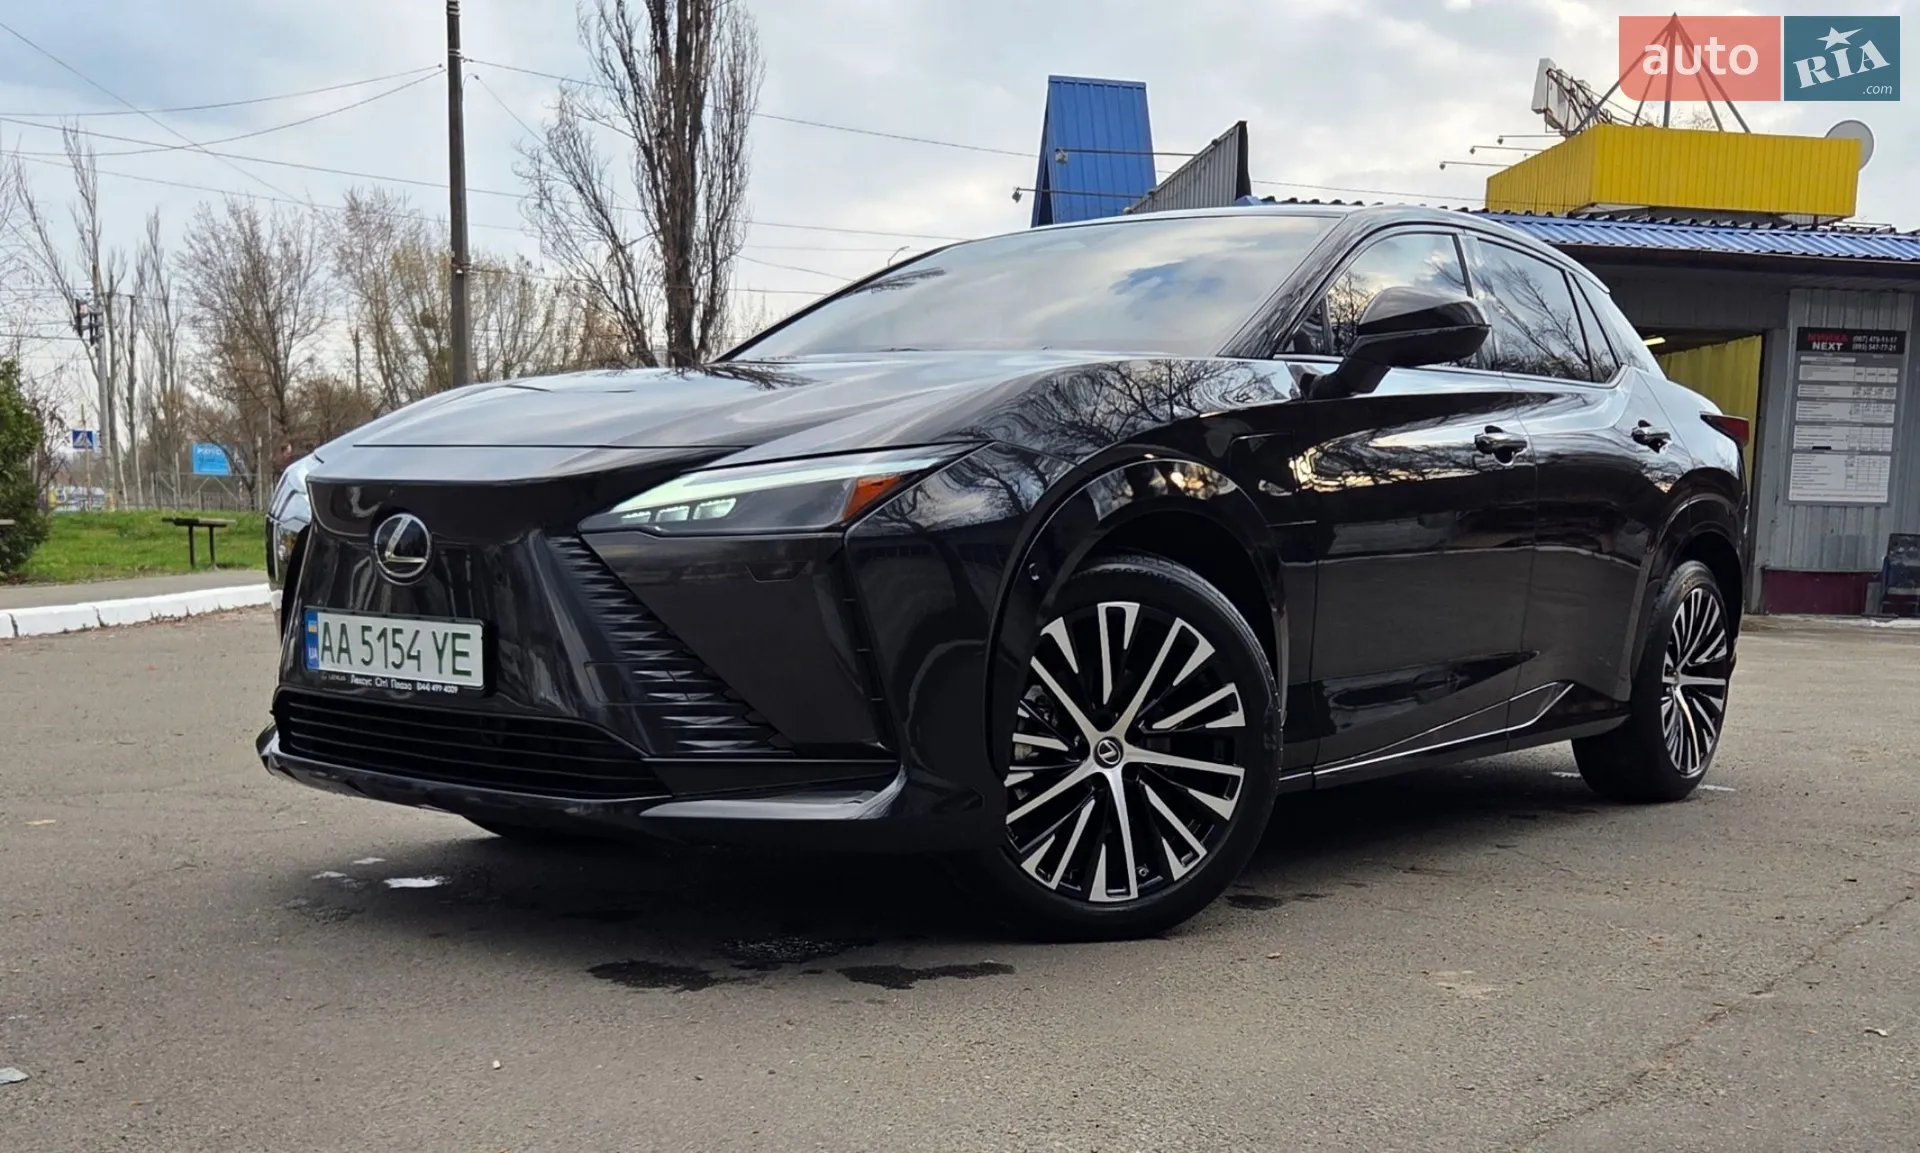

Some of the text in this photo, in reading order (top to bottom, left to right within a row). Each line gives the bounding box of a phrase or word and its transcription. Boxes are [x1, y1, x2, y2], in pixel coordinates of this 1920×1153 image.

[1811, 342, 1844, 351] NEXT
[308, 646, 318, 660] UA
[320, 621, 472, 677] AA 5154 YE
